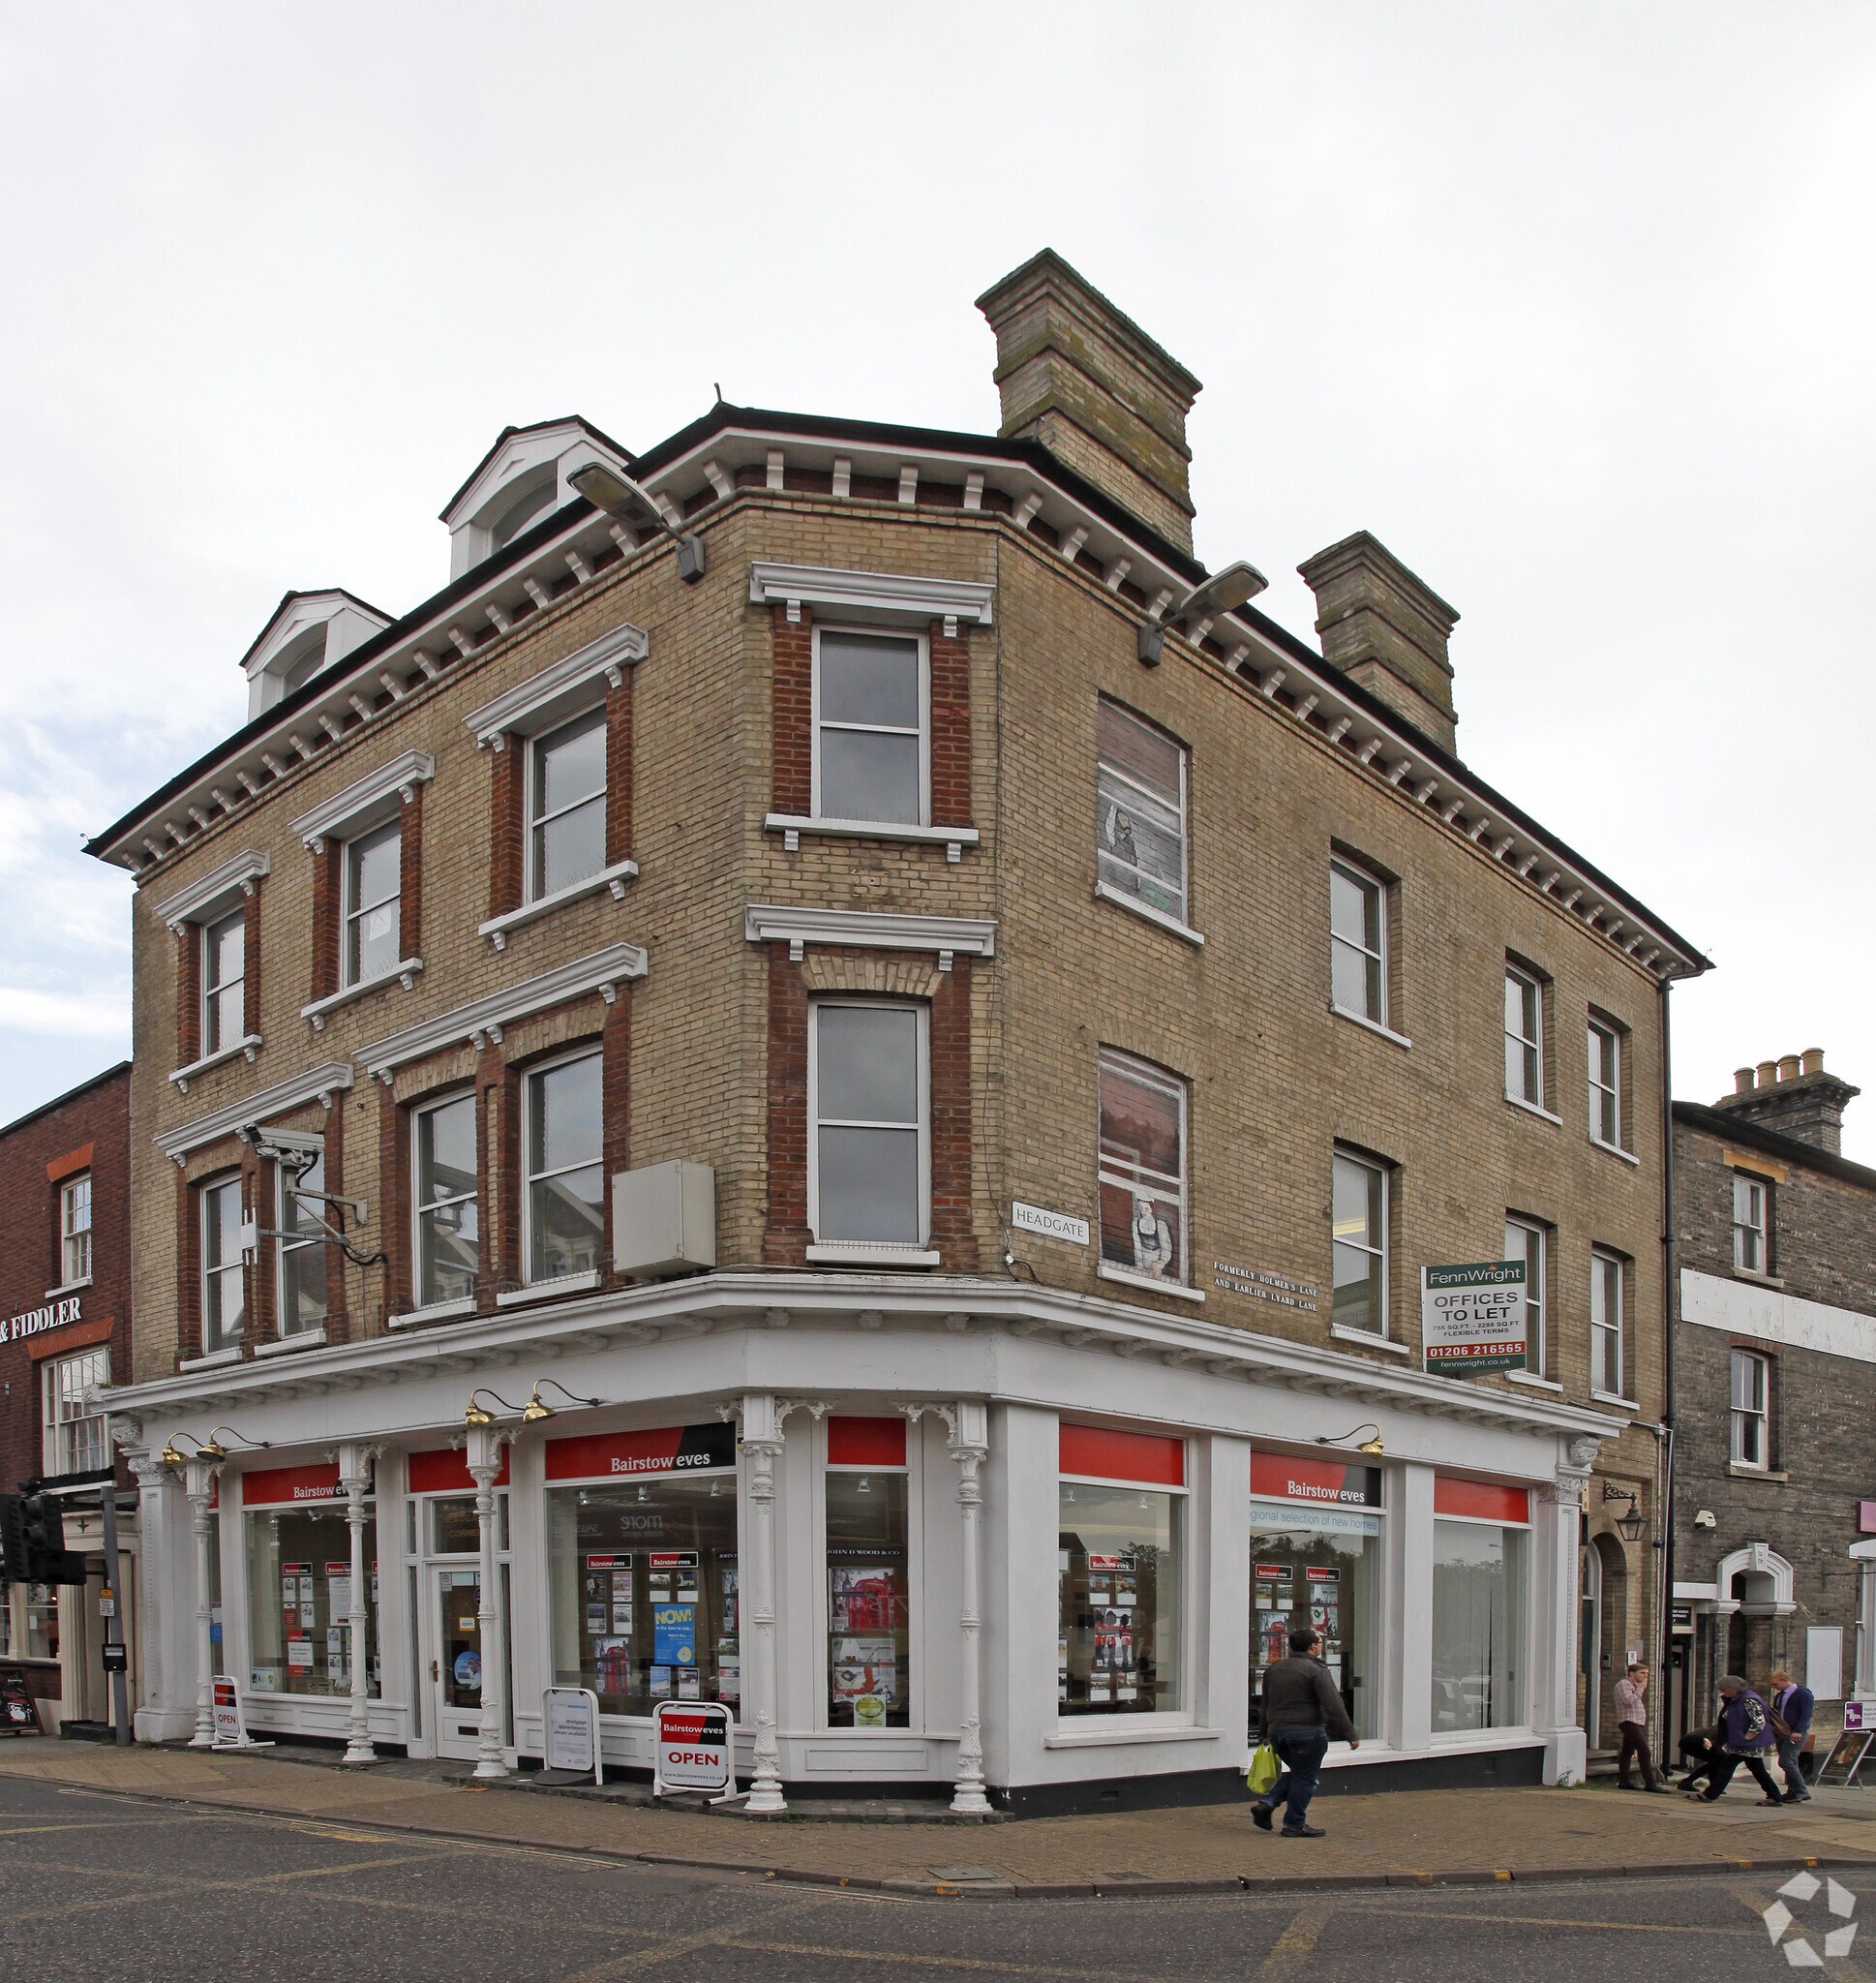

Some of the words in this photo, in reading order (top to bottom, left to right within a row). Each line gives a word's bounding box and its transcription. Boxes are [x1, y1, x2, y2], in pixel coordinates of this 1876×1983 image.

[1016, 1208, 1084, 1236] HEADGATE
[1214, 1261, 1256, 1280] FORMERLY
[1259, 1275, 1296, 1292] HOLMER'S
[1300, 1286, 1317, 1297] LANE
[1430, 1267, 1521, 1285] FennWright
[1215, 1278, 1230, 1289] AND
[1234, 1283, 1267, 1298] EARLIER
[1271, 1294, 1295, 1306] LYARD
[1298, 1300, 1317, 1312] LANE
[1434, 1292, 1519, 1307] OFFICES
[0, 1321, 9, 1343] &
[11, 1297, 81, 1340] FIDDLER
[1441, 1309, 1468, 1322] TO
[1474, 1307, 1510, 1320] LET
[1430, 1346, 1468, 1358] 01206
[1473, 1343, 1522, 1355] 216565
[1440, 1358, 1511, 1368] fennwright.co.uk
[611, 1456, 675, 1472] Bairstow
[676, 1453, 711, 1467] eves
[293, 1485, 335, 1498] Bairstow
[335, 1484, 348, 1495] ev
[1286, 1480, 1339, 1500] Bairstow
[1340, 1490, 1365, 1503] eves
[1281, 1510, 1319, 1525] selection
[1322, 1514, 1330, 1525] of
[1332, 1518, 1348, 1527] new
[1350, 1517, 1377, 1530] homes
[449, 1528, 480, 1538] CORNE
[654, 1608, 692, 1625] NOW!
[307, 1683, 325, 1694] Sales
[329, 1685, 335, 1694] &
[218, 1714, 236, 1724] OPEN
[663, 1724, 703, 1733] Bairstow
[668, 1752, 719, 1766] OPEN
